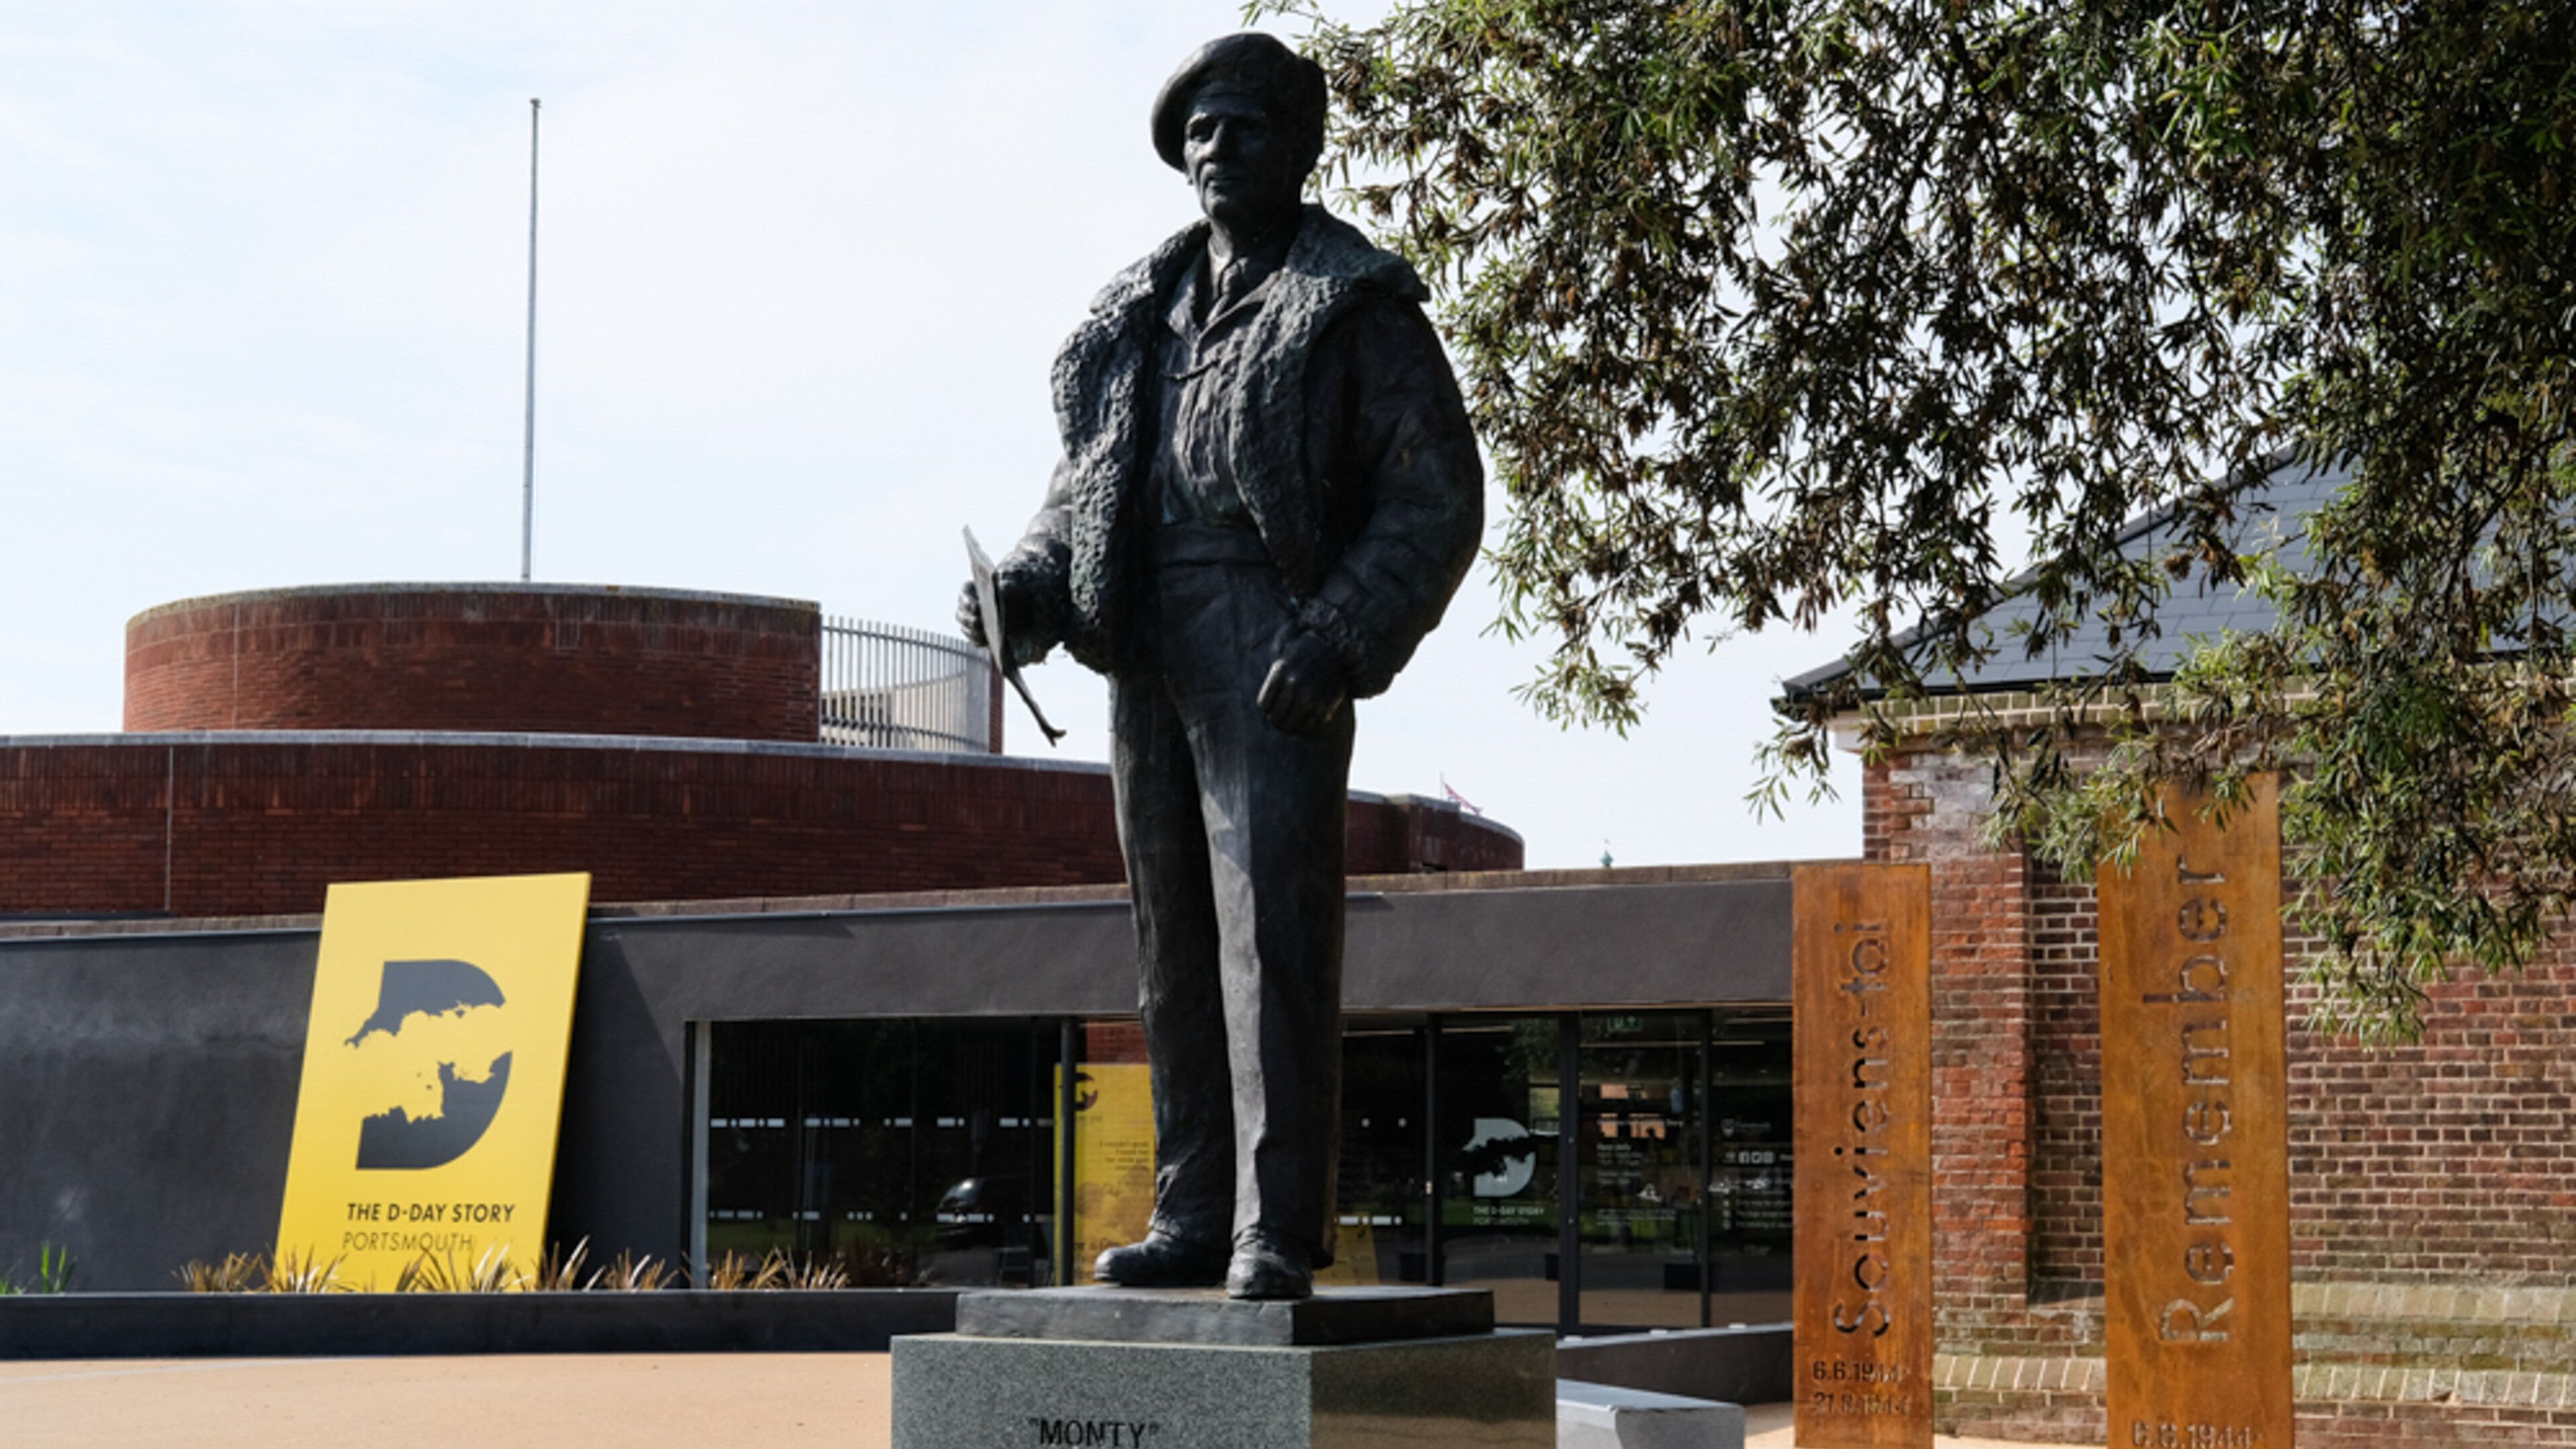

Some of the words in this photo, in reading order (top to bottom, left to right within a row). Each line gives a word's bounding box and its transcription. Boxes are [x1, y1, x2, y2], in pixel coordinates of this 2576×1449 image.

[2143, 855, 2235, 1344] Remember
[1833, 921, 1890, 1338] Souviens-toi
[347, 1203, 381, 1221] THE
[387, 1203, 447, 1222] D-DAY
[452, 1203, 516, 1222] STORY
[342, 1231, 475, 1252] PORTSMOUTH
[1028, 1417, 1161, 1448] "MONTY"
